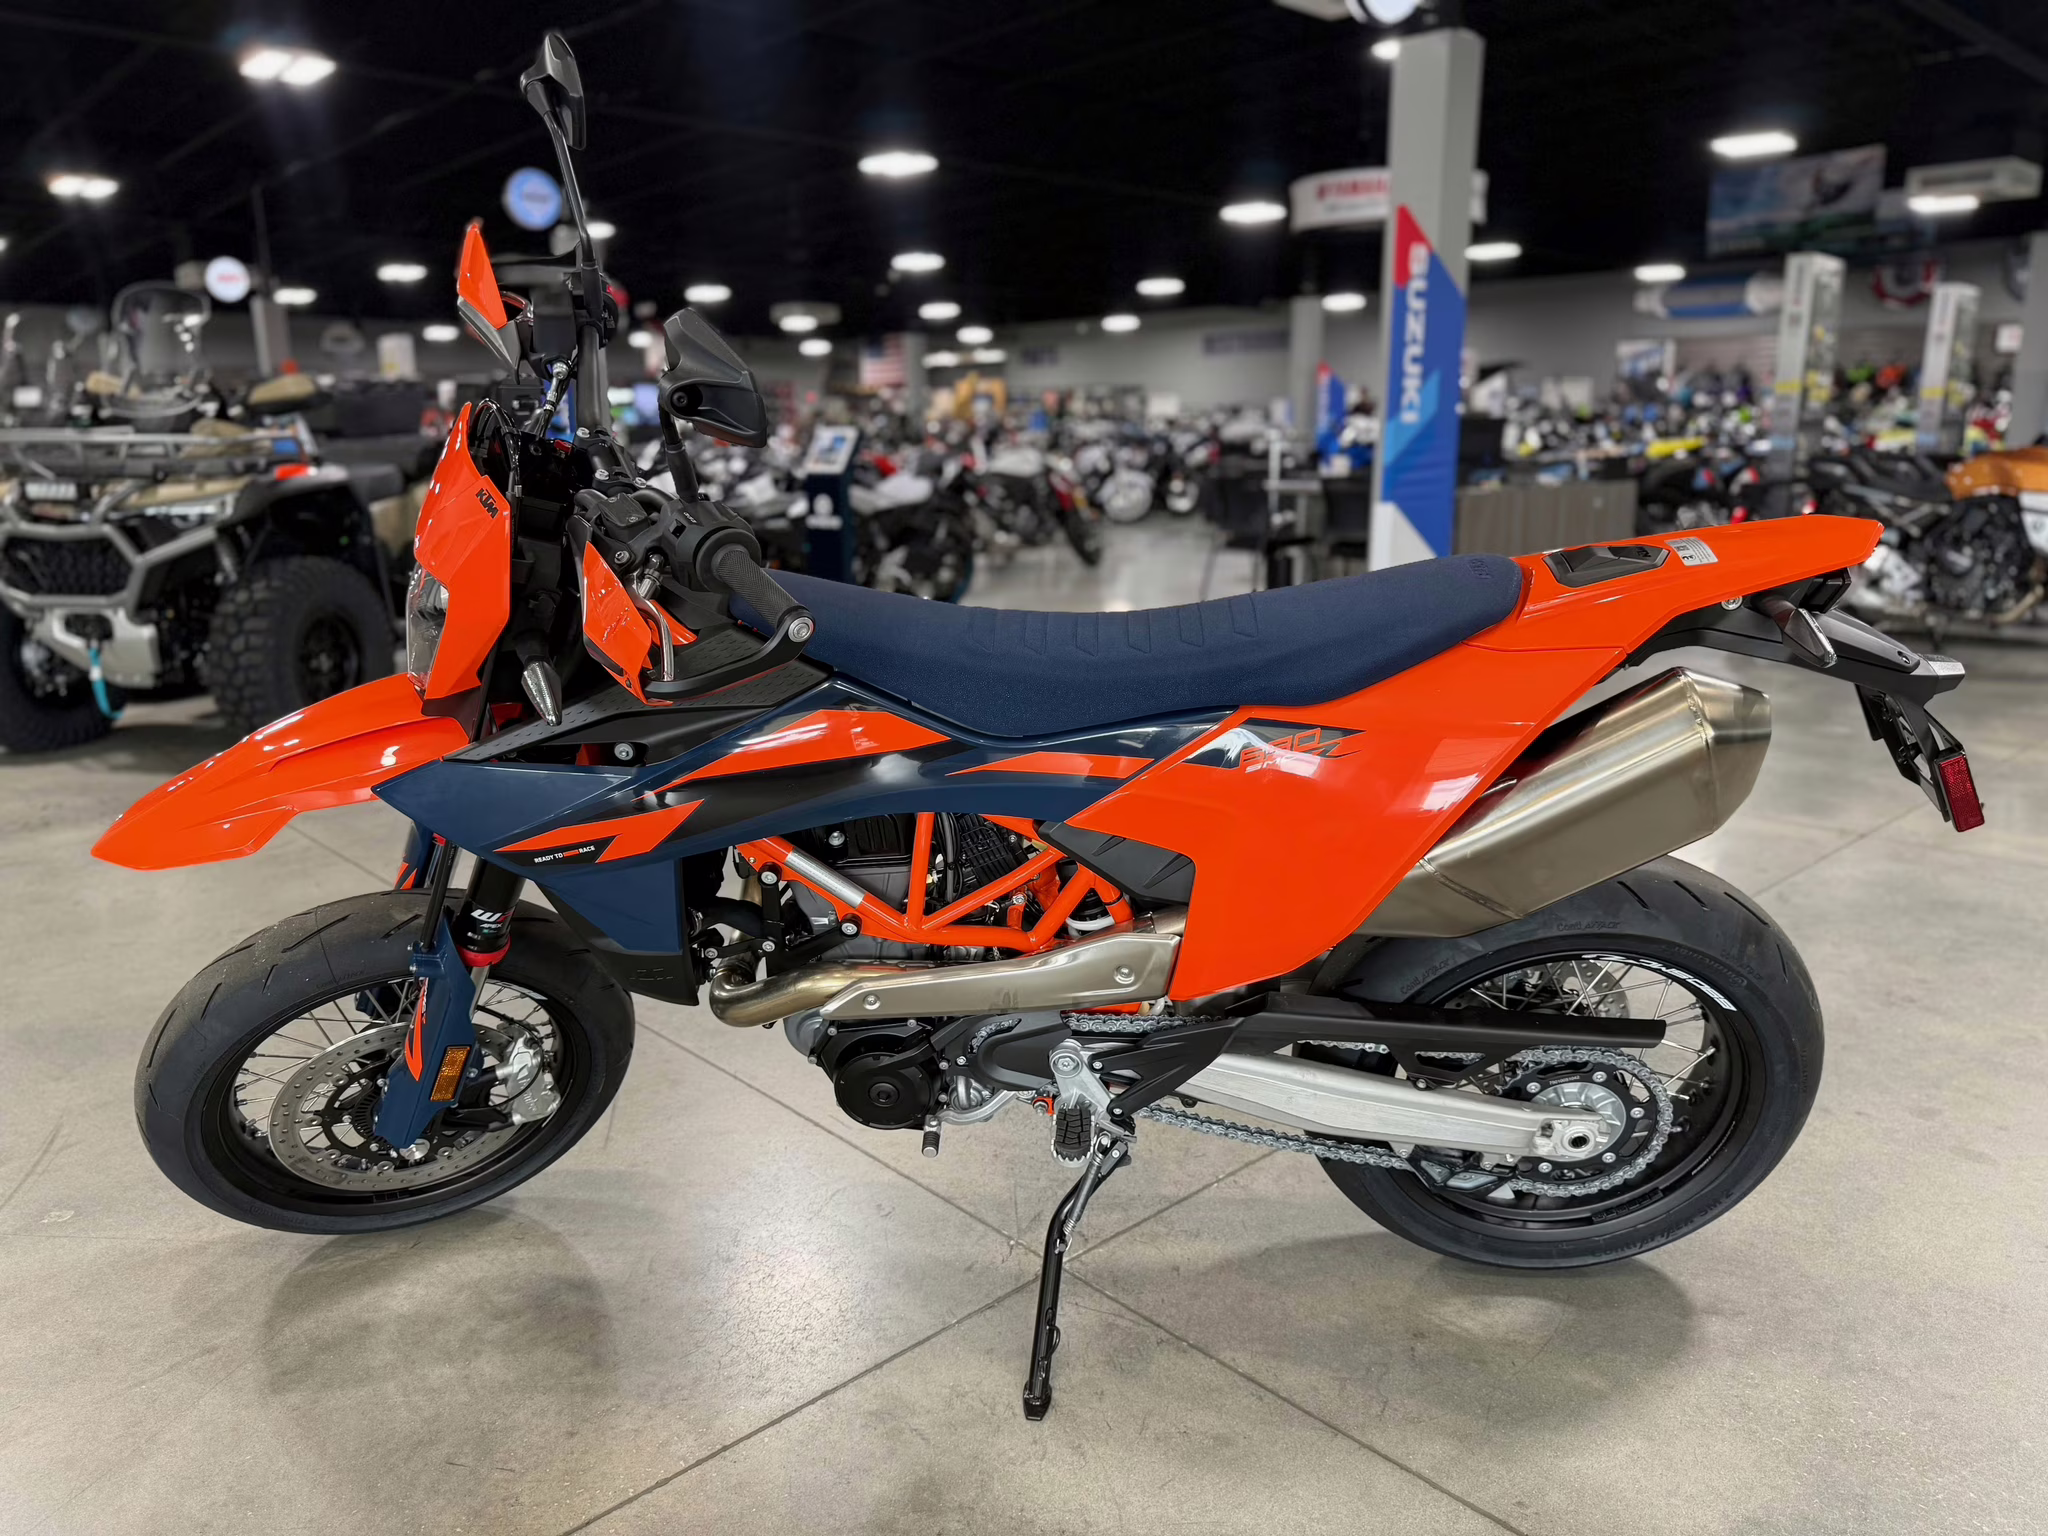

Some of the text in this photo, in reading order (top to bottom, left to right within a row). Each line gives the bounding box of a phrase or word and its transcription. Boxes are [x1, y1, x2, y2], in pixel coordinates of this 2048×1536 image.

[1401, 241, 1430, 425] SUZUKI
[475, 487, 499, 519] KTM
[533, 855, 554, 864] READY
[578, 845, 596, 854] RACE
